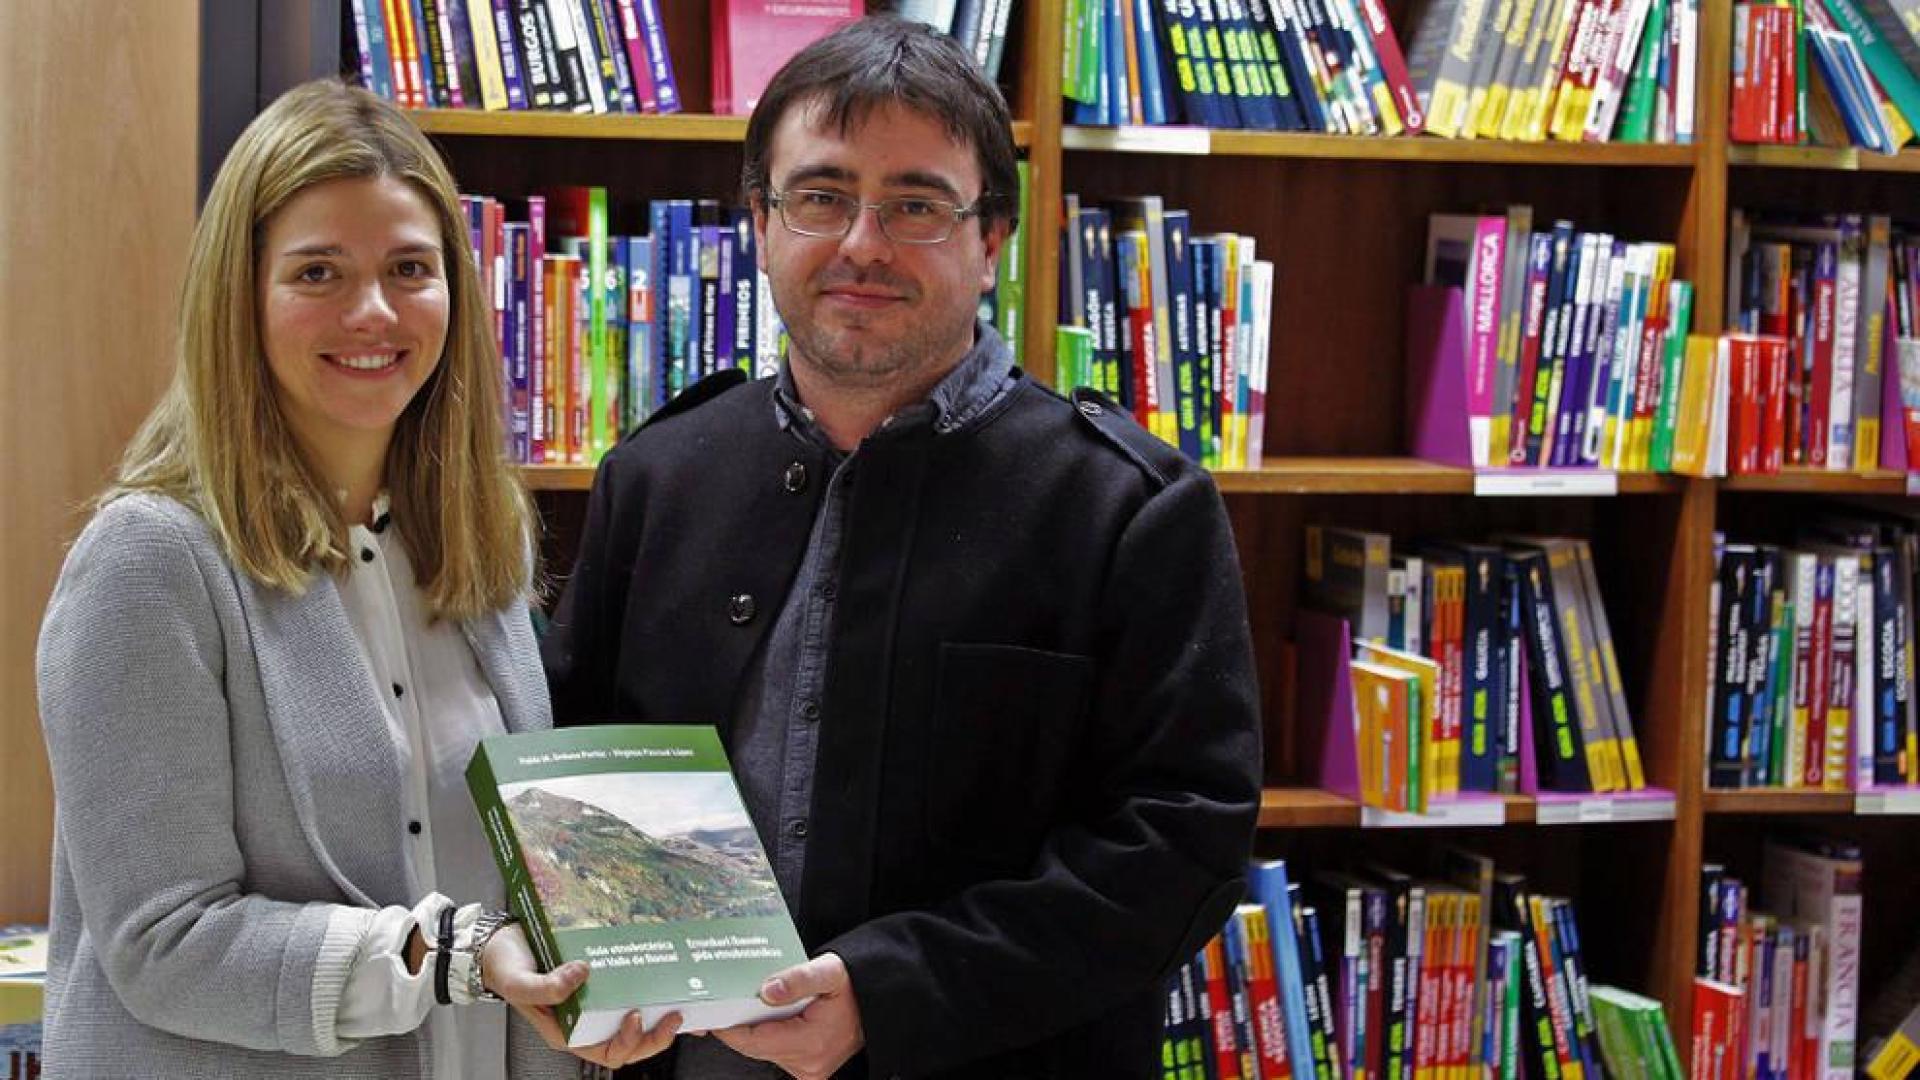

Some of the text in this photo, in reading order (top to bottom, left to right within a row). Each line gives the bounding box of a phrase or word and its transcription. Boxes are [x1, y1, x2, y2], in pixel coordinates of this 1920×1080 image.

[519, 12, 546, 85] BURGOS
[632, 270, 646, 290] 2
[737, 278, 750, 348] PIRINEOS
[1473, 232, 1502, 332] MALLORCA
[1104, 302, 1115, 348] HUESCA
[1176, 294, 1188, 351] ASTURIAS
[1196, 302, 1206, 354] ASTURIAS
[1833, 276, 1855, 391] AUSTRIA
[1143, 322, 1157, 405] ZARAGOZA
[1222, 325, 1234, 403] ASTURIAS
[1636, 327, 1656, 413] MALLORCA
[1476, 628, 1487, 679] GALICIA
[1881, 618, 1895, 679] ESCOCIA
[1386, 956, 1410, 1011] TENERIFE
[1521, 939, 1547, 1008] CANTABRIA
[1834, 906, 1858, 1029] FRANCIA
